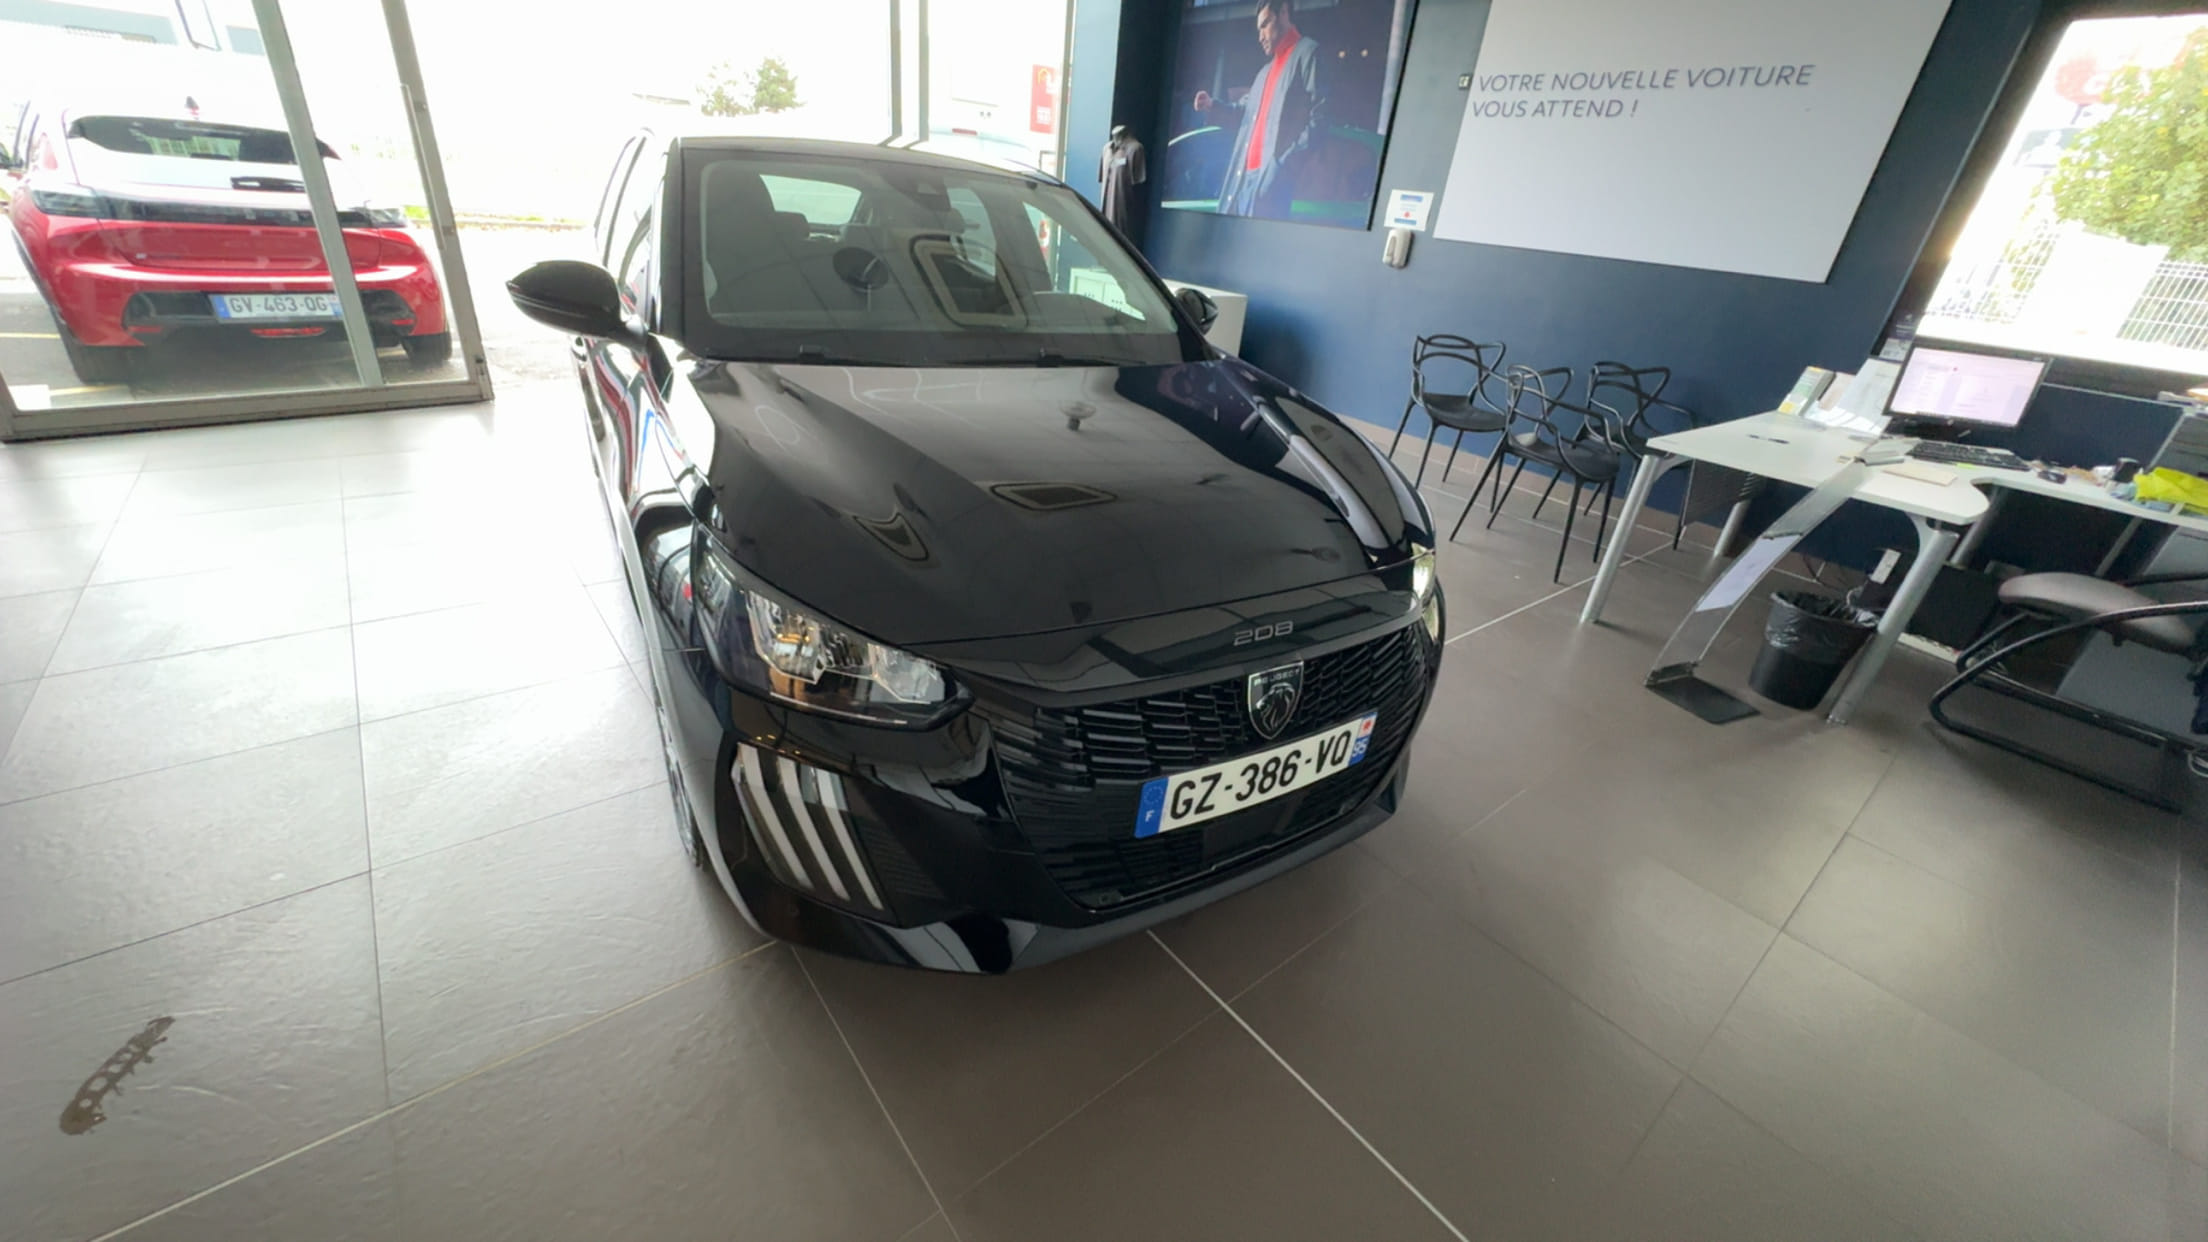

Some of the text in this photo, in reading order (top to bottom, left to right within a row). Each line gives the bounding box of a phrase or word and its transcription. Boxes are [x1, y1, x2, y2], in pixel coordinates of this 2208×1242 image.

[1479, 64, 1815, 92] VOTRE NOUVELLE VOITURE
[1472, 99, 1638, 118] VOUS ATTEND !
[1234, 621, 1294, 646] 208
[1169, 730, 1352, 820] GZ-386-VQ
